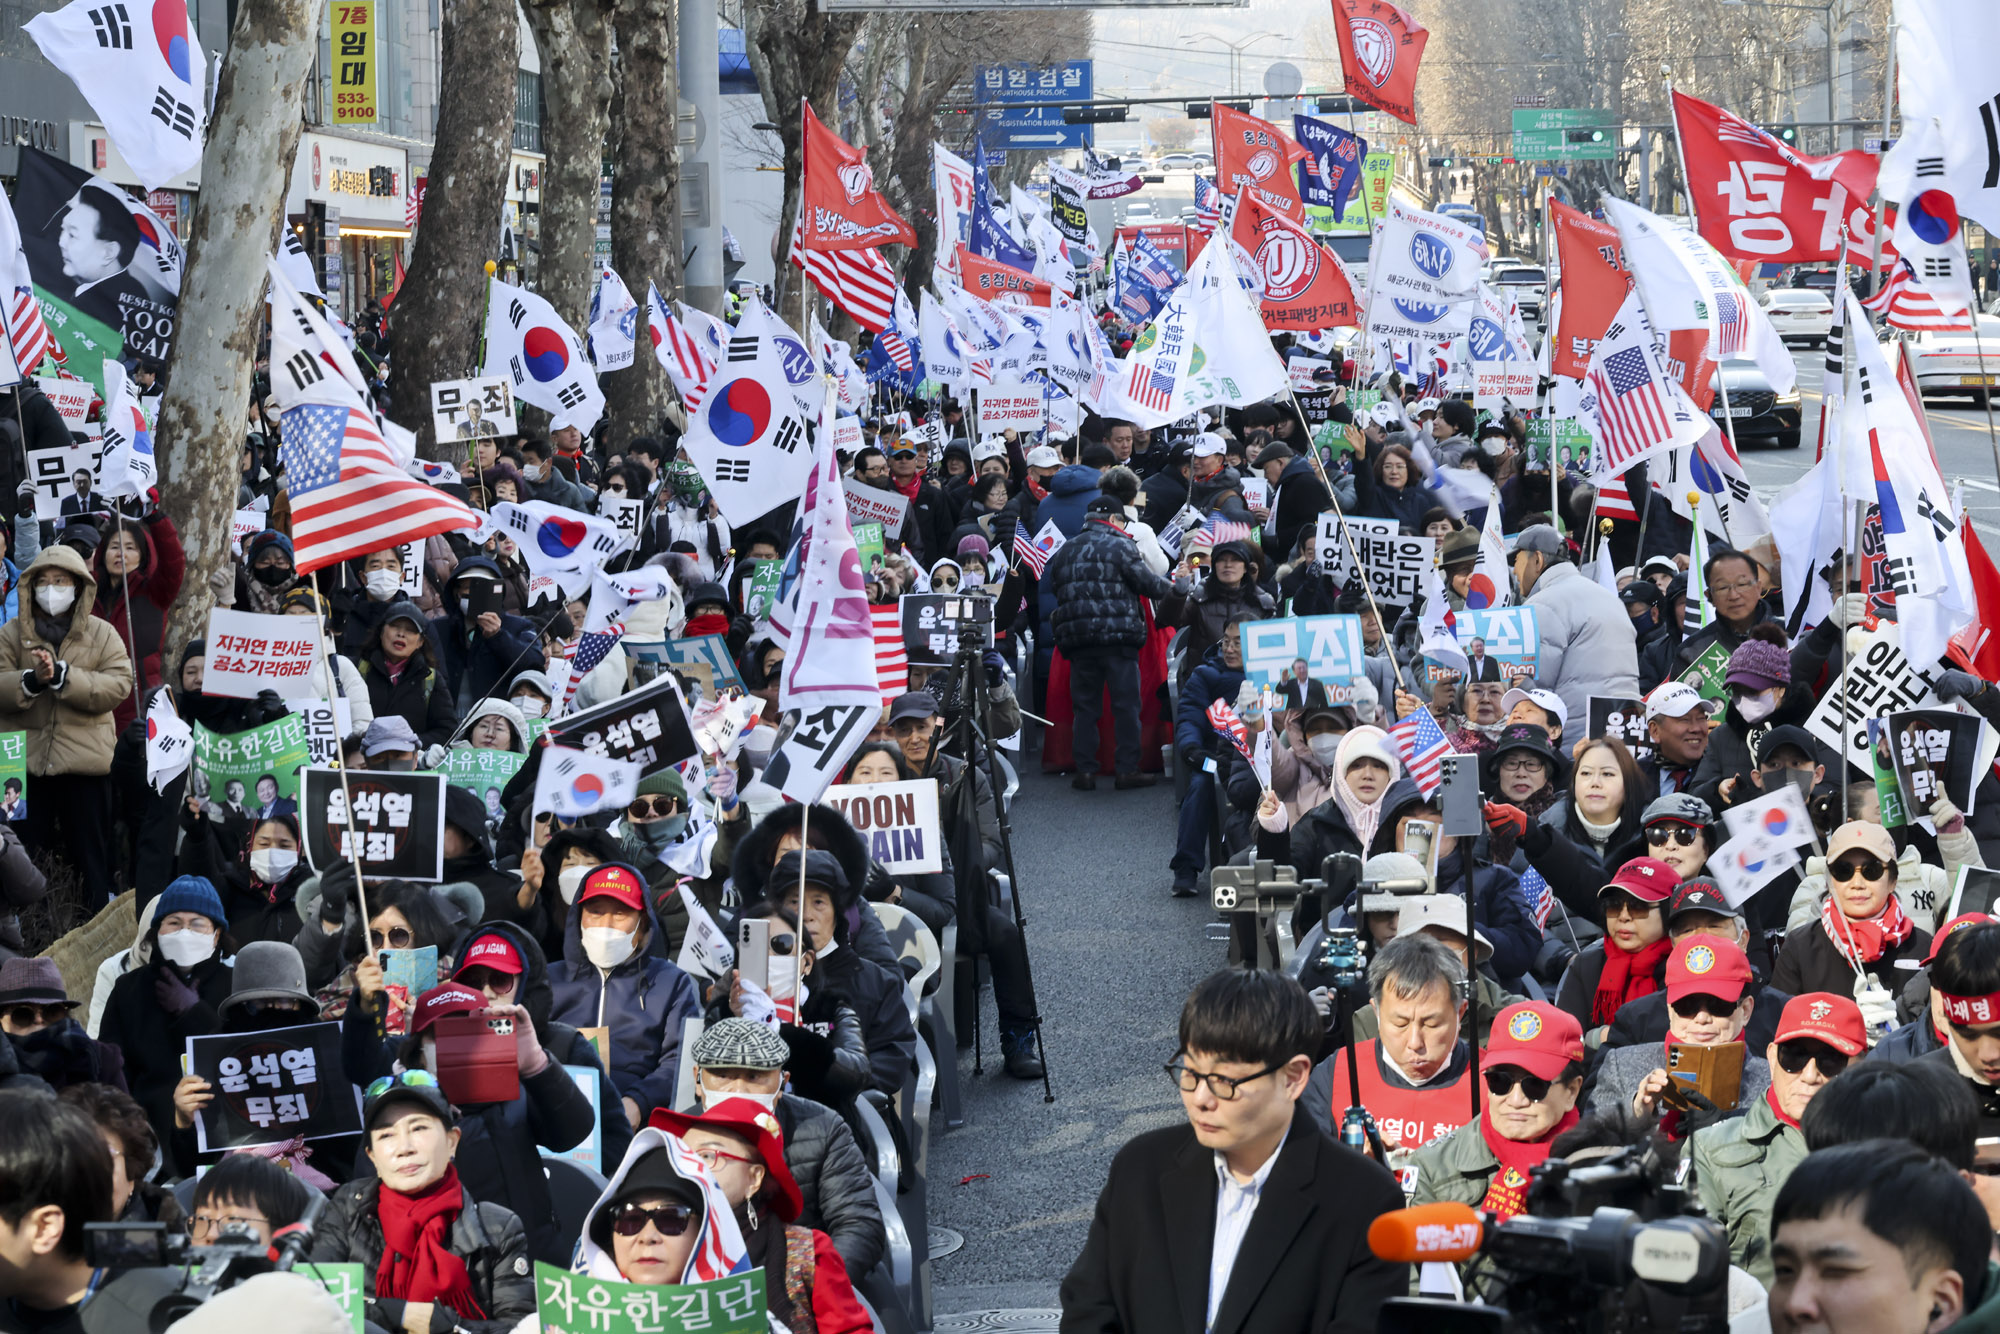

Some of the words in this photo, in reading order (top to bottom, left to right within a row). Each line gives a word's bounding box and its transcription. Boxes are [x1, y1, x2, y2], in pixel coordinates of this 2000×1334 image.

[338, 7, 367, 25] 7층
[340, 31, 367, 86] 임대
[337, 92, 369, 104] 533-
[337, 106, 375, 118] 9100
[998, 119, 1042, 127] REGISTRATION
[1407, 213, 1464, 238] 자유민주주의수호
[1414, 238, 1448, 277] 해사
[979, 272, 1036, 293] 충청남도
[1268, 287, 1293, 296] ARMY
[1387, 274, 1432, 292] 해군사관학교
[119, 292, 158, 311] RESET
[158, 301, 176, 318] KO
[1263, 302, 1348, 323] 거부패방지대
[117, 304, 173, 338] YOO
[1371, 323, 1420, 338] 해군사관학교
[120, 324, 171, 361] AGAI
[1155, 302, 1187, 374] 大韓民國
[931, 364, 963, 379] 해군사관
[1478, 374, 1505, 384] 지귀연
[1507, 374, 1533, 385] 판사는
[59, 394, 86, 406] 판사는
[437, 380, 512, 424] 무죄
[982, 398, 1011, 409] 지귀연
[1013, 397, 1039, 408] 판사는
[1478, 385, 1534, 397] 공소기각하라!
[982, 409, 1040, 421] 공소기각하라!
[1307, 409, 1328, 420] 무죄
[1735, 407, 1751, 417] 8014
[845, 490, 871, 507] 지귀연
[873, 501, 901, 517] 판사는
[1244, 491, 1262, 501] 사는
[1350, 537, 1424, 571] 내란은
[1348, 565, 1423, 600] 없었다
[216, 634, 268, 656] 지귀연
[271, 640, 313, 657] 판사는
[1246, 616, 1362, 678] 무죄
[212, 655, 312, 677] 공소기각하라!
[1427, 664, 1461, 680] Free
[1498, 662, 1536, 679] Yoon
[1325, 682, 1355, 705] Yoo
[1820, 641, 1900, 735] 내란은
[195, 716, 304, 762] 자유한길단
[583, 708, 662, 758] 윤석열
[793, 706, 867, 771] 죄
[1606, 711, 1648, 742] 윤석
[1900, 728, 1951, 767] 윤석열
[327, 787, 413, 827] 윤석열
[831, 792, 916, 830] YOON
[340, 830, 395, 863] 무죄
[864, 828, 924, 866] AIN
[594, 881, 632, 893] MARINES
[1672, 884, 1725, 909] SUPERMAN
[485, 942, 507, 955] AGAIN
[427, 991, 451, 1007] COCO
[1943, 996, 1991, 1022] 이재명
[219, 1046, 317, 1093] 윤석열
[245, 1093, 309, 1128] 무죄
[1416, 1223, 1479, 1252] 연합뉴스TV
[543, 1276, 761, 1333] 자유한길단
